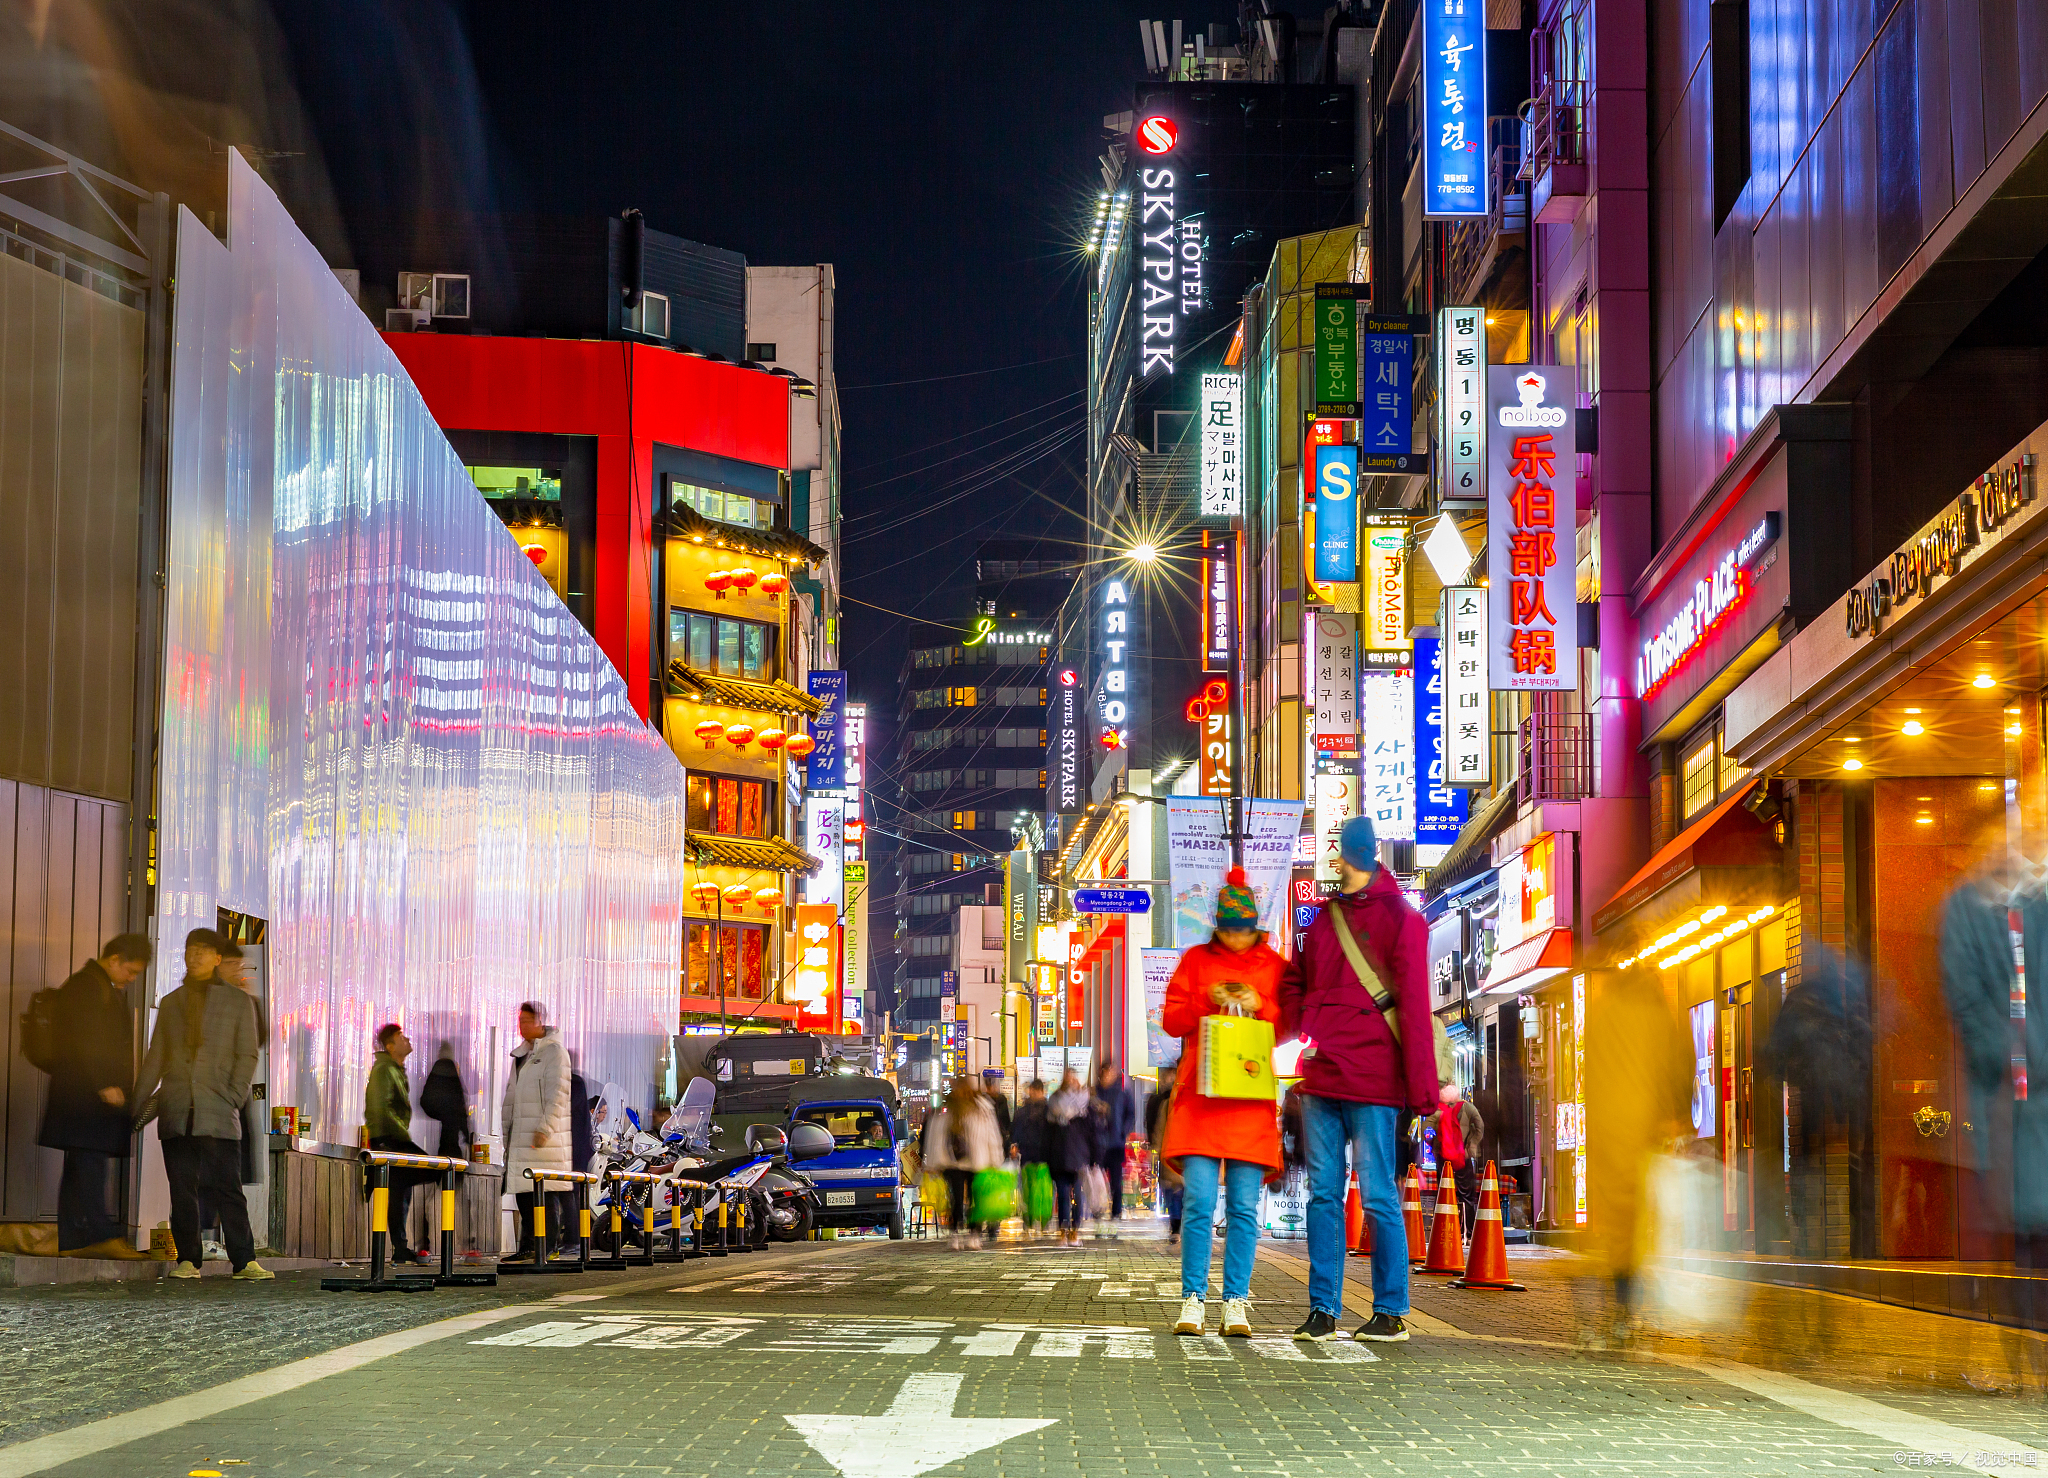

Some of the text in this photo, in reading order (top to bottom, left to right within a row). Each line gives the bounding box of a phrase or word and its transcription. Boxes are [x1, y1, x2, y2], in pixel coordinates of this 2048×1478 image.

[1437, 185, 1475, 194] 778-8592
[1142, 168, 1175, 377] SKYPARK
[1181, 220, 1201, 315] HOTEL
[1322, 327, 1349, 341] 행복
[1369, 320, 1409, 332] Dry cleaner
[1370, 339, 1409, 355] 경일사
[1204, 377, 1238, 389] RICH
[1328, 343, 1348, 398] 부동산
[1207, 400, 1235, 427] 足
[1375, 361, 1402, 446] 세탁소
[1205, 431, 1219, 501] マッサージ
[1222, 431, 1236, 502] 발마사지
[1367, 456, 1397, 468] Laundry
[1212, 503, 1228, 512] 4F
[1323, 541, 1349, 549] CLINIC
[1510, 433, 1558, 675] 乐伯部队锅
[1330, 555, 1340, 563] 3F
[1307, 593, 1317, 602] 4F
[987, 631, 1024, 644] Nine
[1637, 657, 1645, 699] A
[1695, 549, 1736, 636] PLACE
[1319, 645, 1333, 724] 생선구이
[1339, 645, 1354, 725] 갈치조림
[1457, 597, 1480, 772] 소박한대폿집
[1062, 689, 1076, 809] HOTEL SKYPARK
[1374, 739, 1406, 821] 사계진미
[1090, 899, 1122, 907] Myeongdong
[847, 886, 858, 985] Nature Collection
[1273, 1200, 1307, 1210] NOODL
[1283, 1190, 1301, 1198] NO.1
